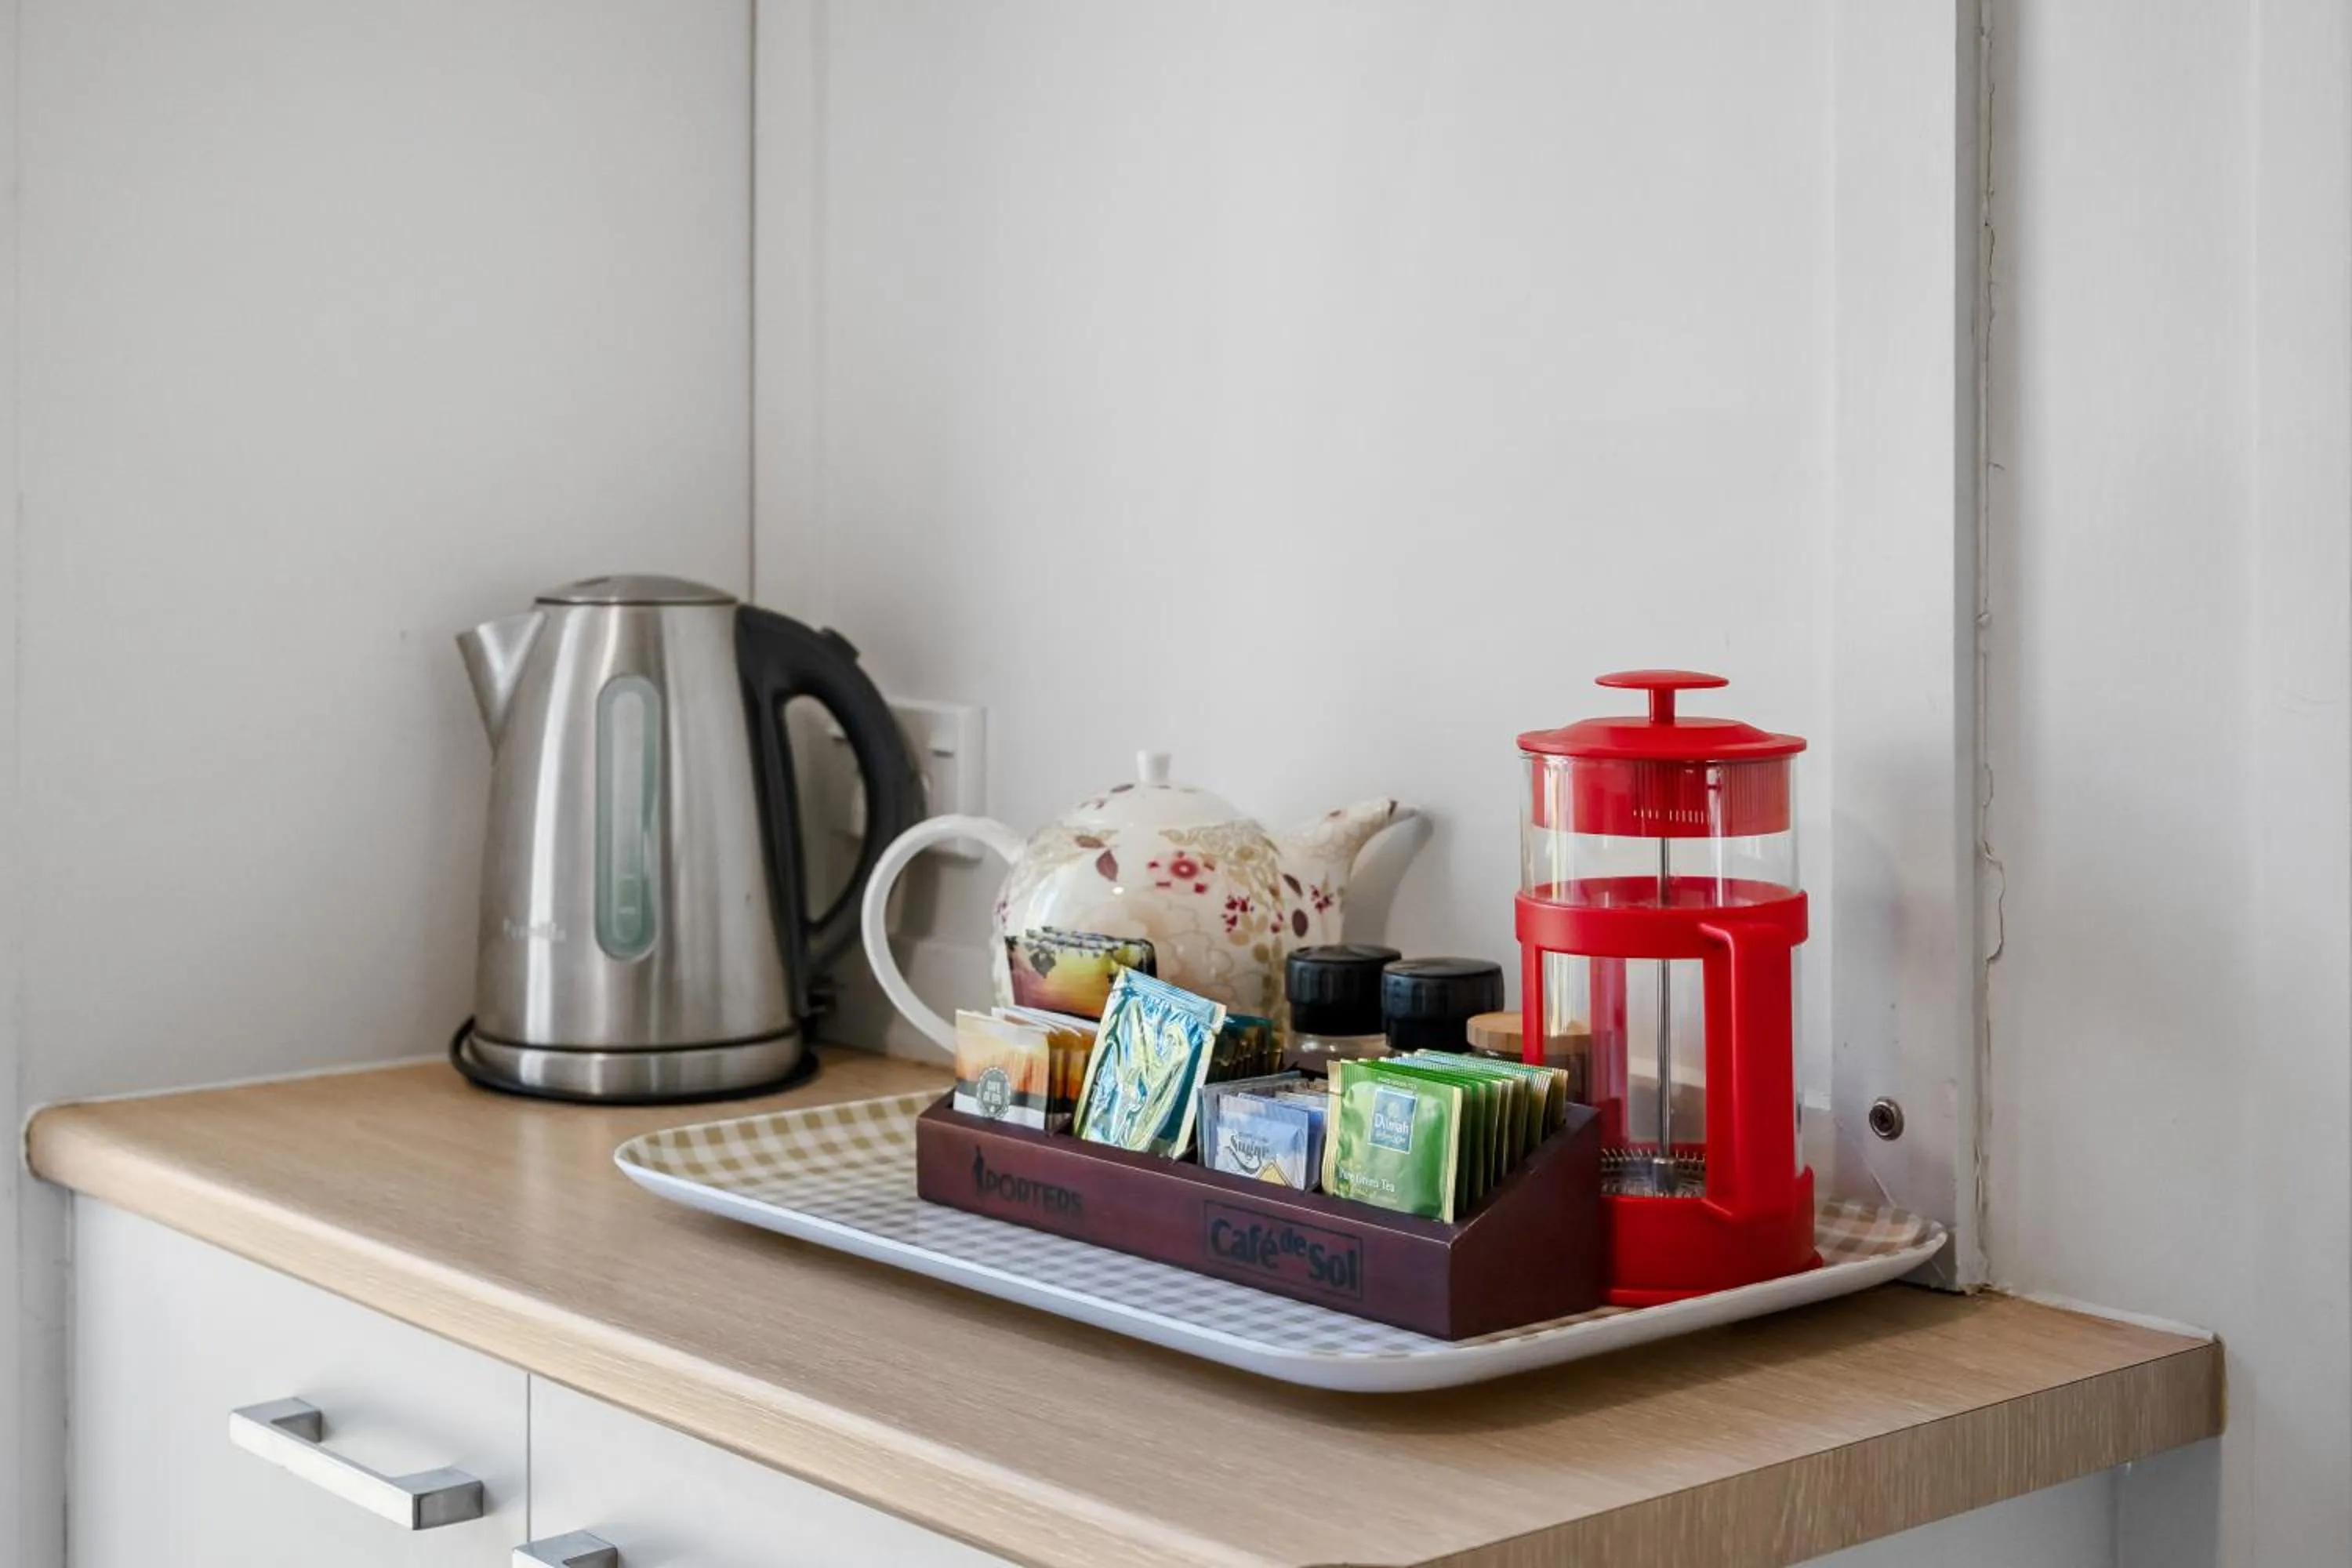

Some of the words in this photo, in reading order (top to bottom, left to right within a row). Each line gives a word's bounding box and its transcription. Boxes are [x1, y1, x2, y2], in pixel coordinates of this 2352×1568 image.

[1225, 1134, 1270, 1174] Sugar
[985, 1168, 1083, 1218] PORTERS
[1381, 1178, 1395, 1192] Tea
[1211, 1218, 1278, 1269] Café
[1279, 1227, 1306, 1256] de
[1308, 1243, 1357, 1290] Sol
